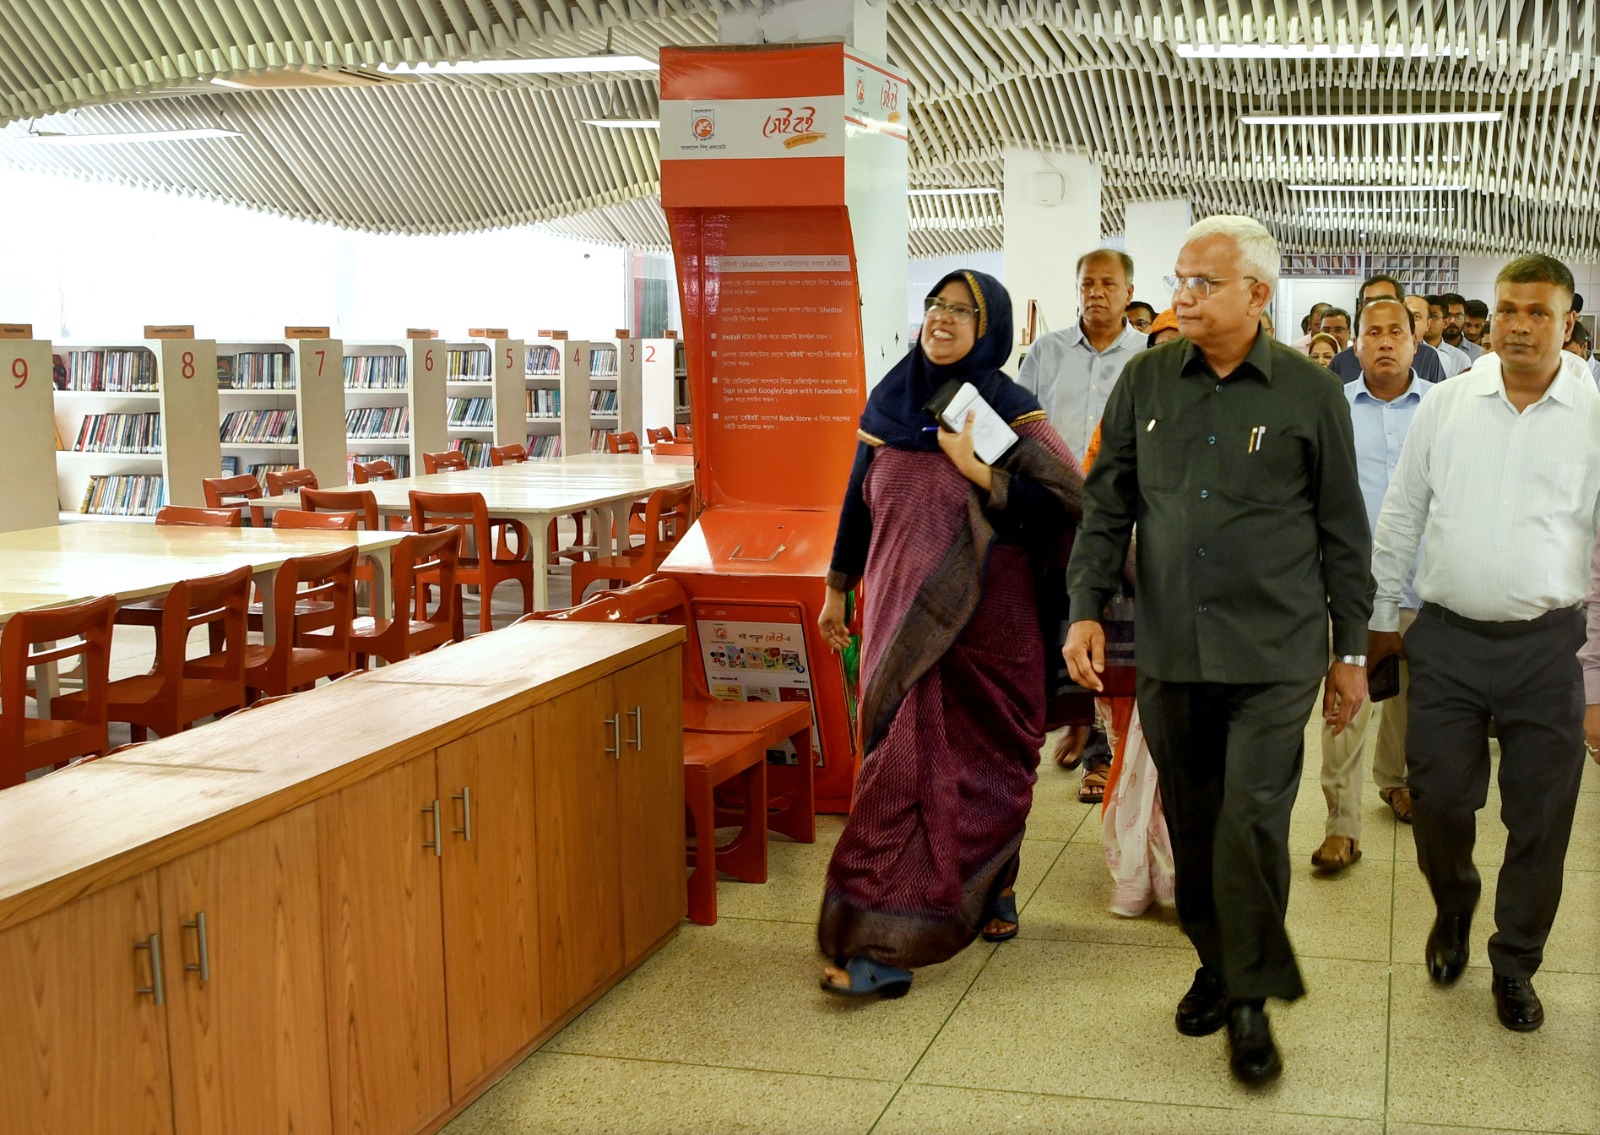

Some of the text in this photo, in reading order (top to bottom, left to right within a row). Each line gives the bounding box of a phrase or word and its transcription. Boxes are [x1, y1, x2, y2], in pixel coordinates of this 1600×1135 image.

[315, 350, 326, 376] 7
[425, 349, 434, 371] 6
[506, 348, 513, 369] 5
[573, 347, 580, 367] 4
[629, 345, 635, 362] 3
[644, 345, 657, 363] 2
[11, 357, 29, 390] 9
[181, 351, 196, 379] 8
[723, 387, 736, 395] Sign
